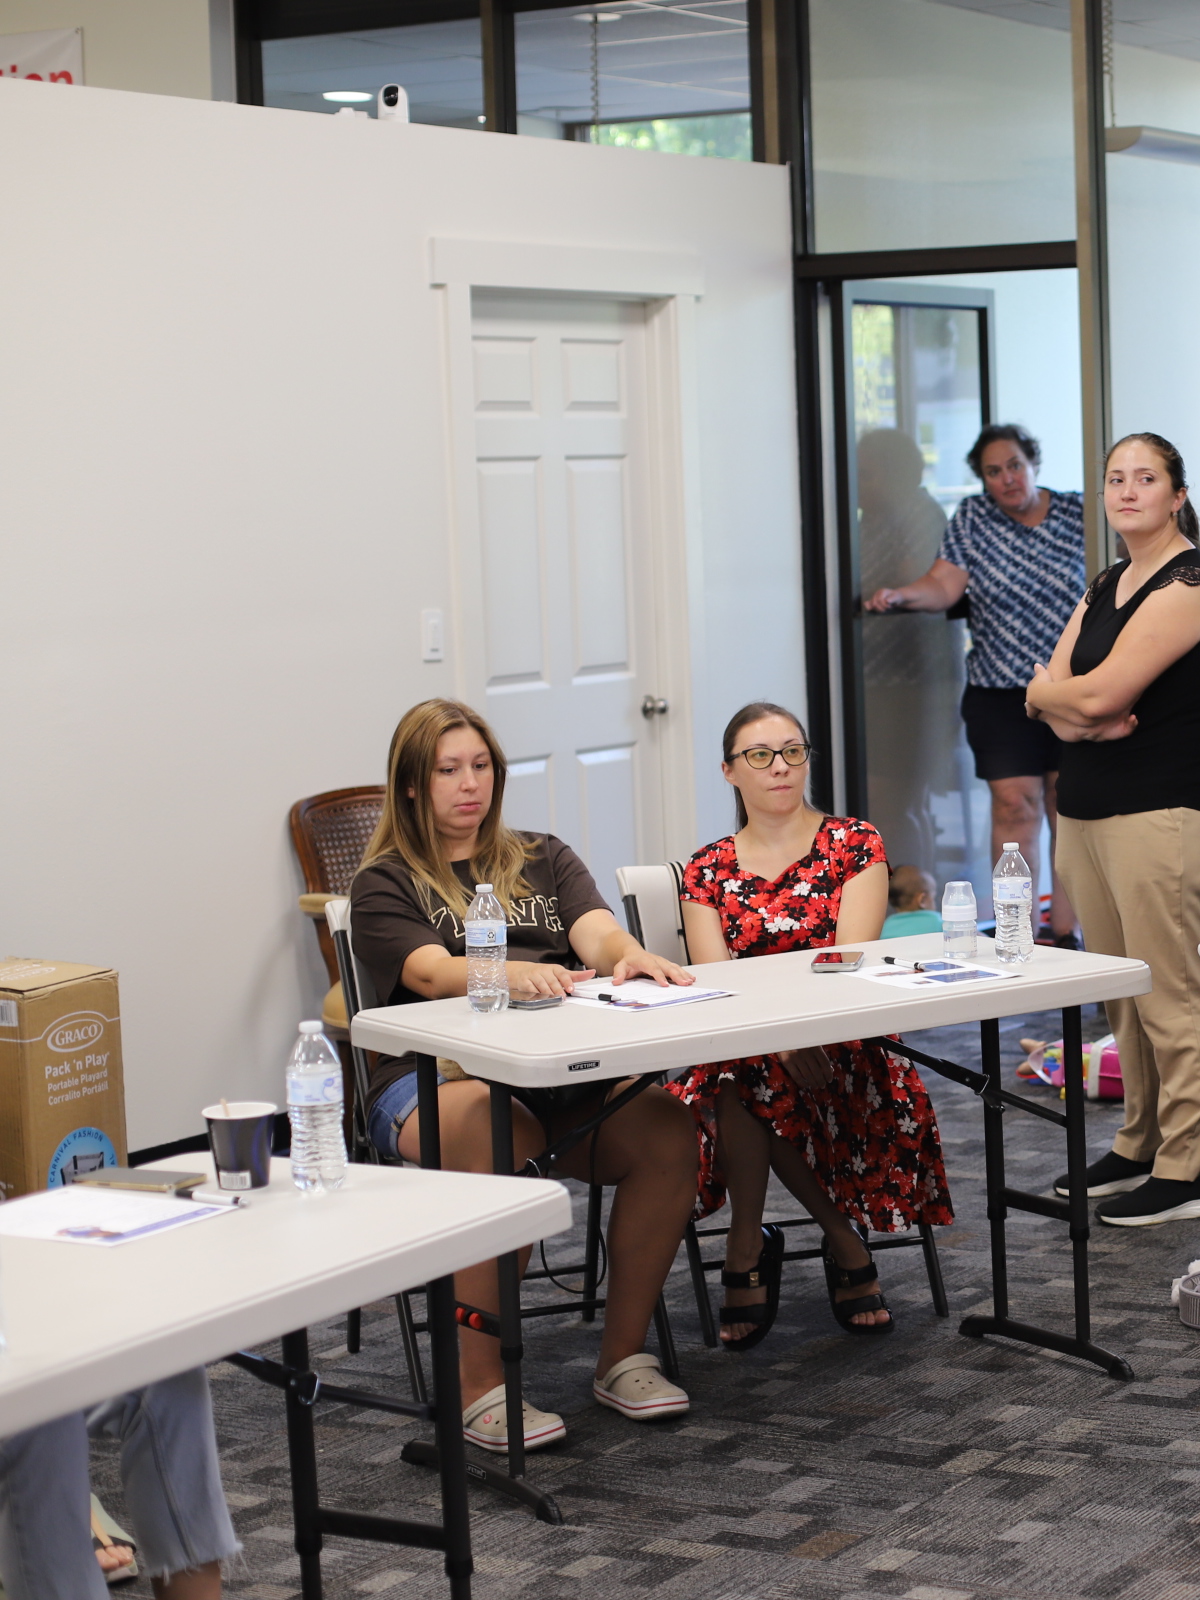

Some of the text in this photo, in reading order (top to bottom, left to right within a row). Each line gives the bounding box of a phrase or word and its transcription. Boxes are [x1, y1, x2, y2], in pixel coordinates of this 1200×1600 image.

[55, 1024, 98, 1046] GRACO
[45, 1061, 71, 1079] Pack
[85, 1054, 108, 1069] Play
[571, 1062, 597, 1071] LIFETIME
[47, 1068, 108, 1093] Portable Playard
[48, 1080, 109, 1106] Corralito Portátil
[49, 1130, 104, 1183] CARNIVAL FASHION
